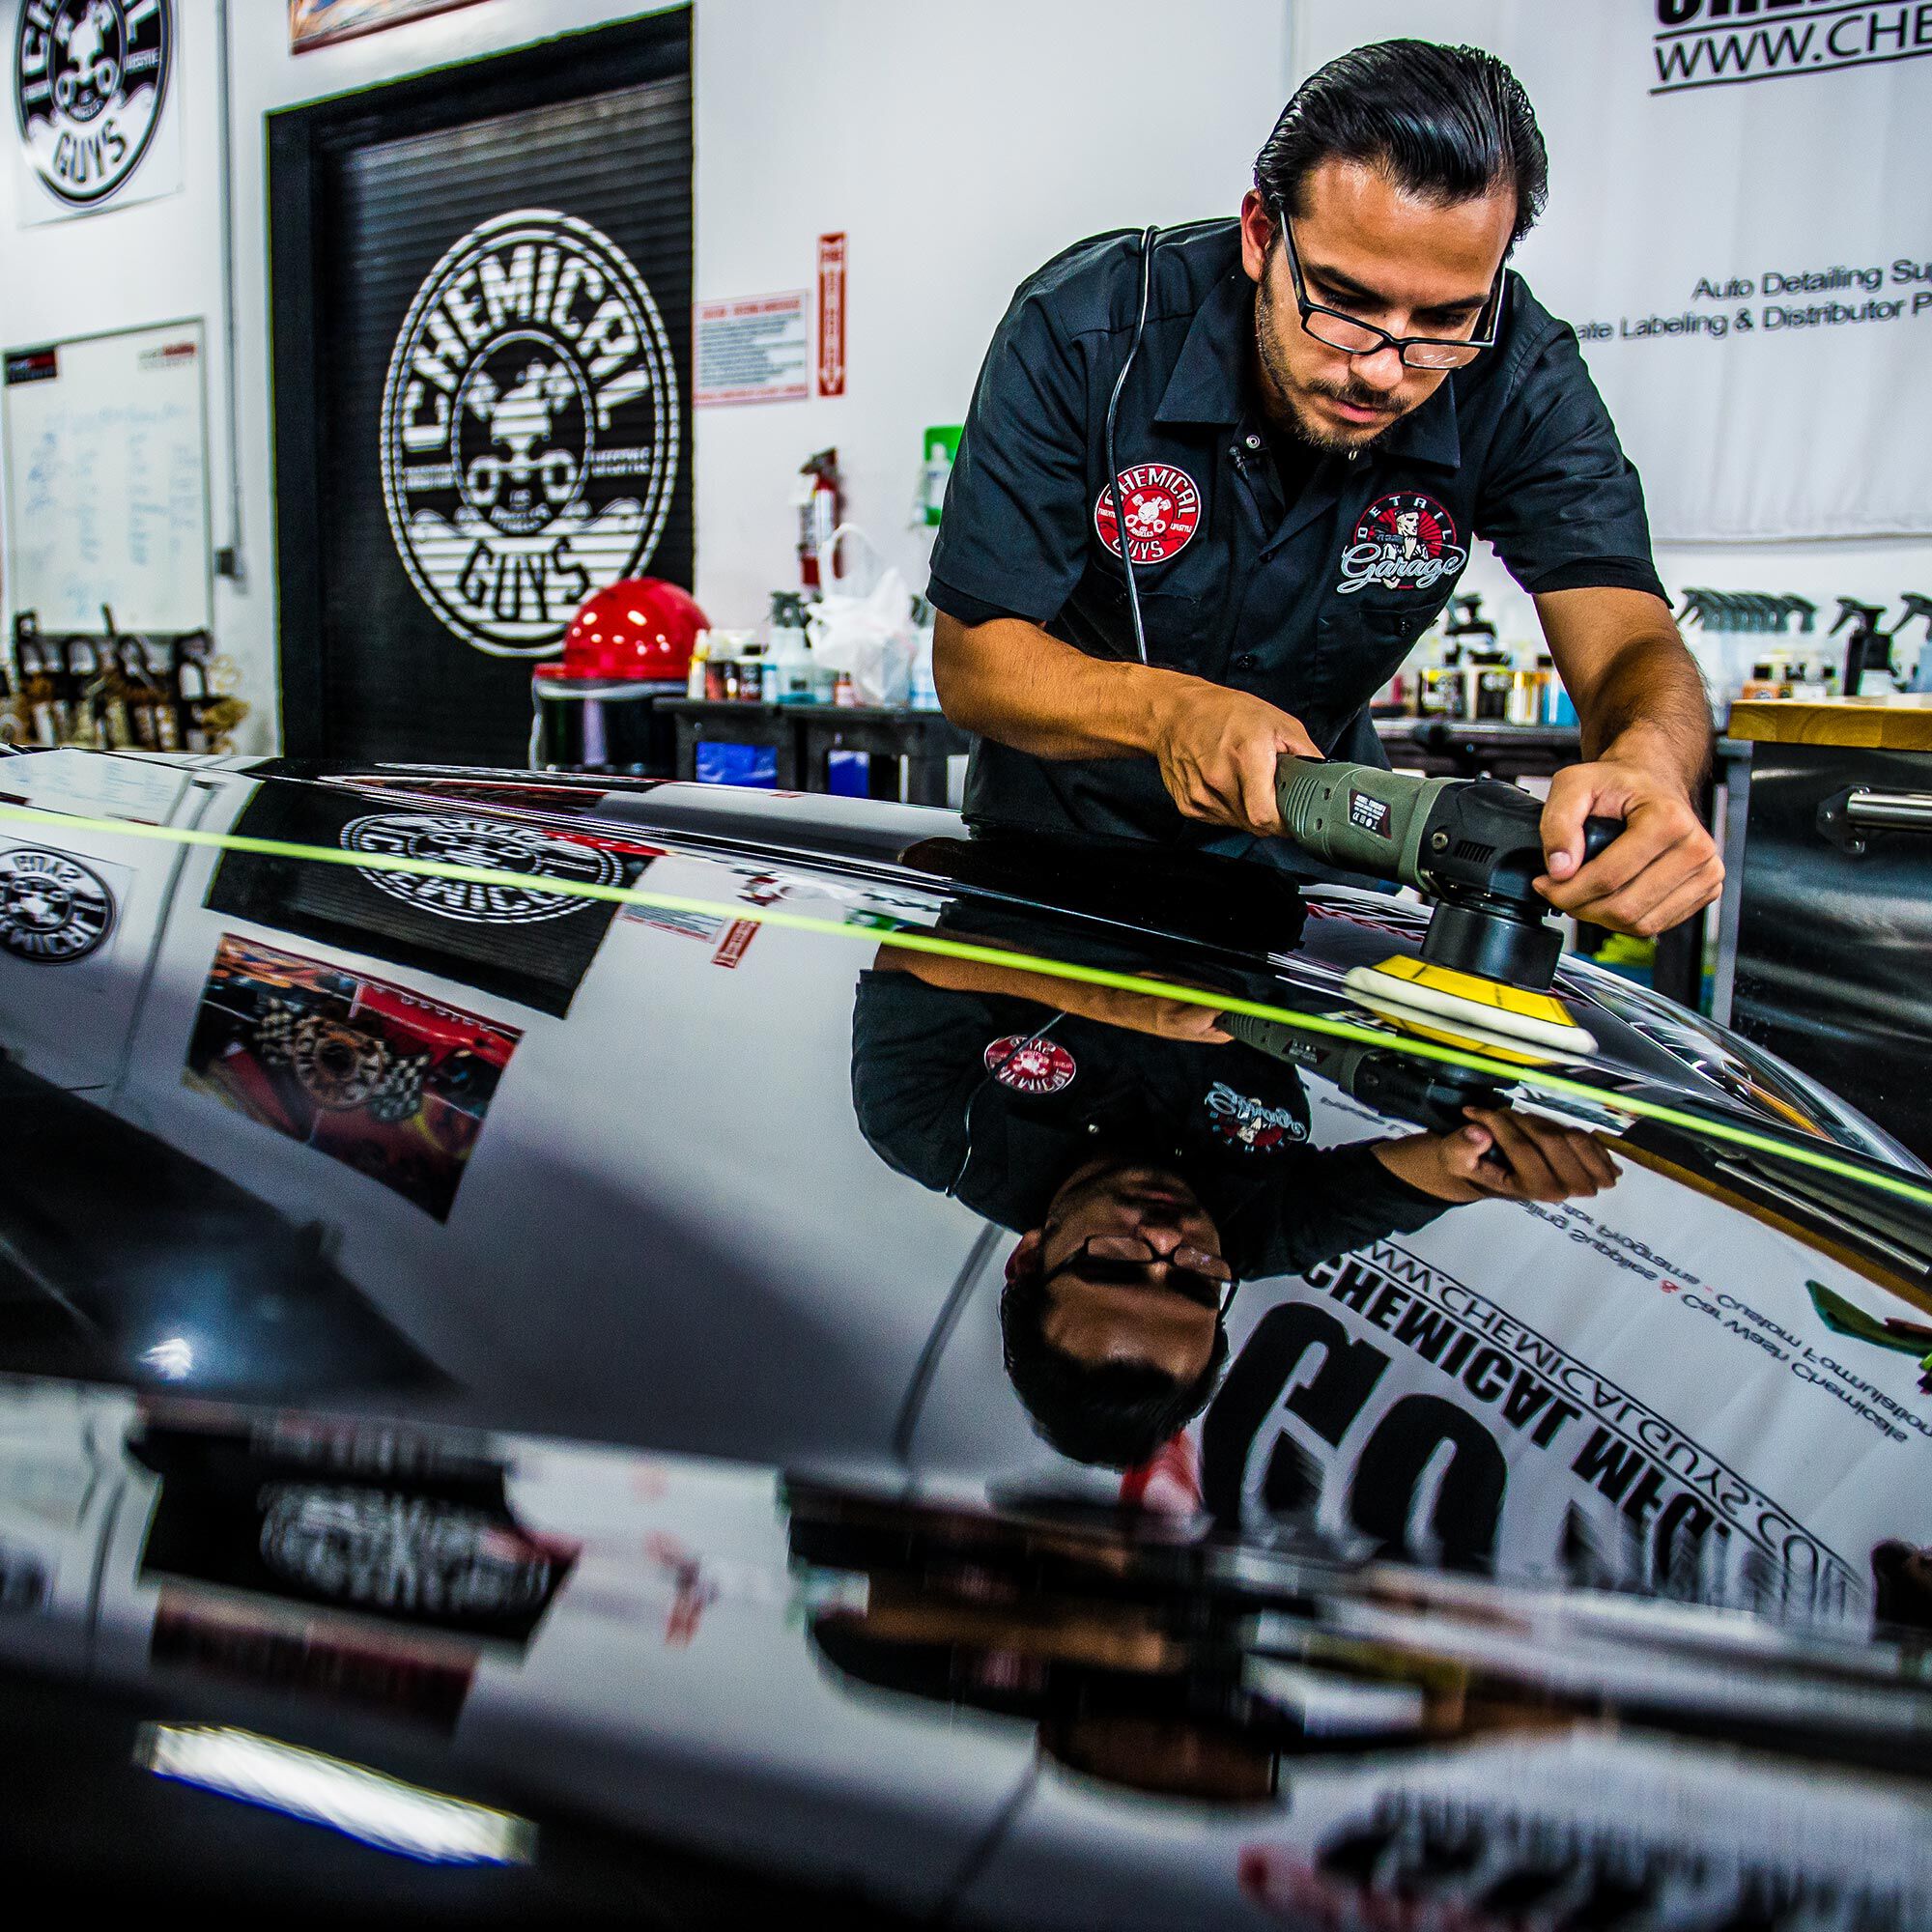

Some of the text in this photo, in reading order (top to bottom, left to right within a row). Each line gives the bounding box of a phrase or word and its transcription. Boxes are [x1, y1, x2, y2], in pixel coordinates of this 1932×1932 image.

[53, 119, 127, 184] GUYS
[1690, 277, 1755, 302] Auto
[1760, 266, 1883, 296] Detailing
[1619, 312, 1730, 340] Labeling
[1735, 306, 1754, 333] &
[1761, 298, 1908, 331] Distributor
[402, 244, 650, 452] CHEMICAL
[1357, 496, 1452, 541] DETAIL
[459, 537, 590, 621] GUYS
[1337, 542, 1467, 593] Garage
